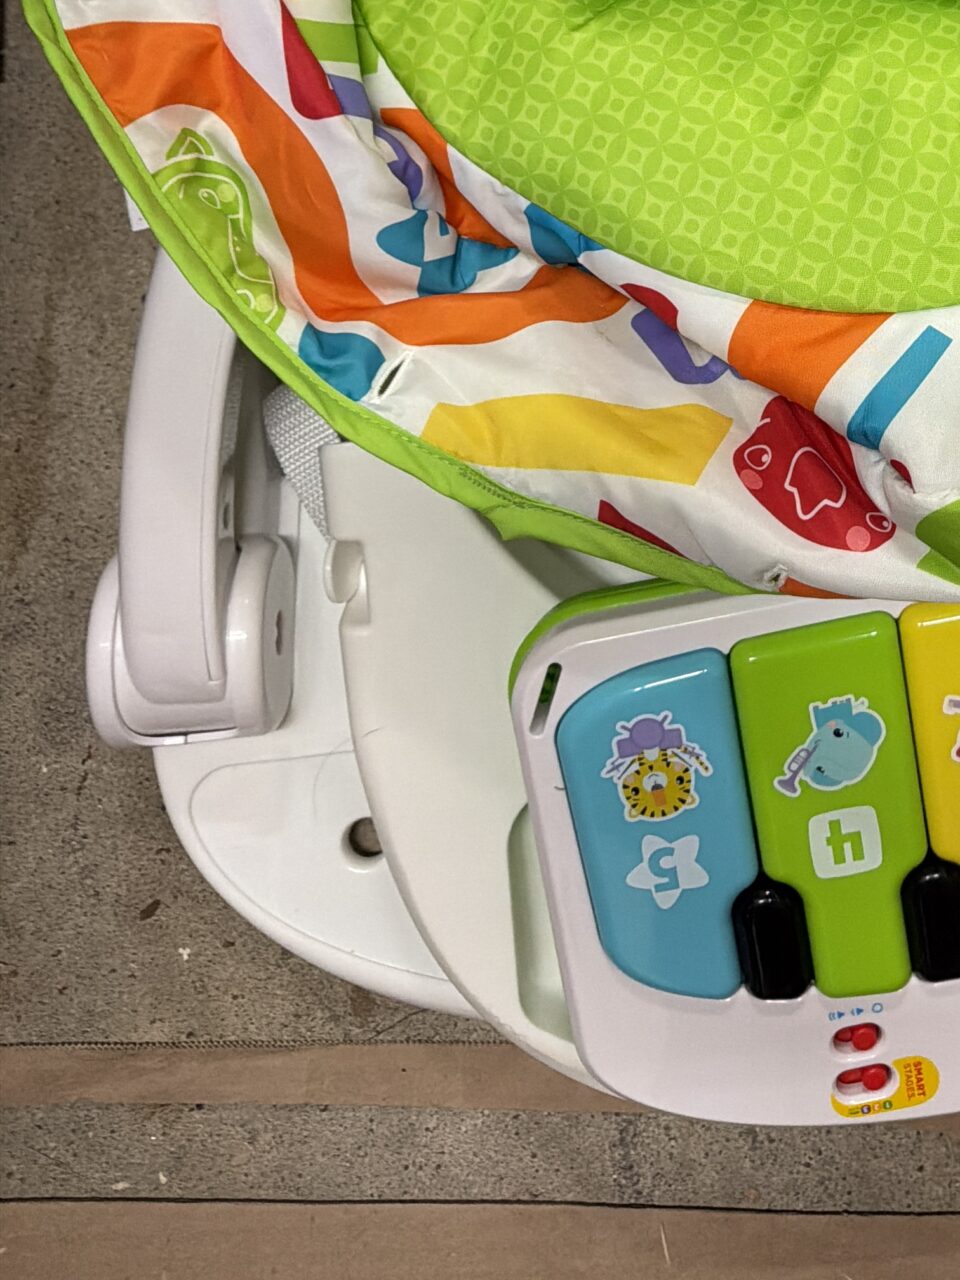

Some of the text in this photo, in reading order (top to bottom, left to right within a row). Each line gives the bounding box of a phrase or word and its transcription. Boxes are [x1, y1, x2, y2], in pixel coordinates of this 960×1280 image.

[826, 819, 865, 865] 4
[647, 846, 680, 894] 5
[912, 1060, 926, 1098] SMART
